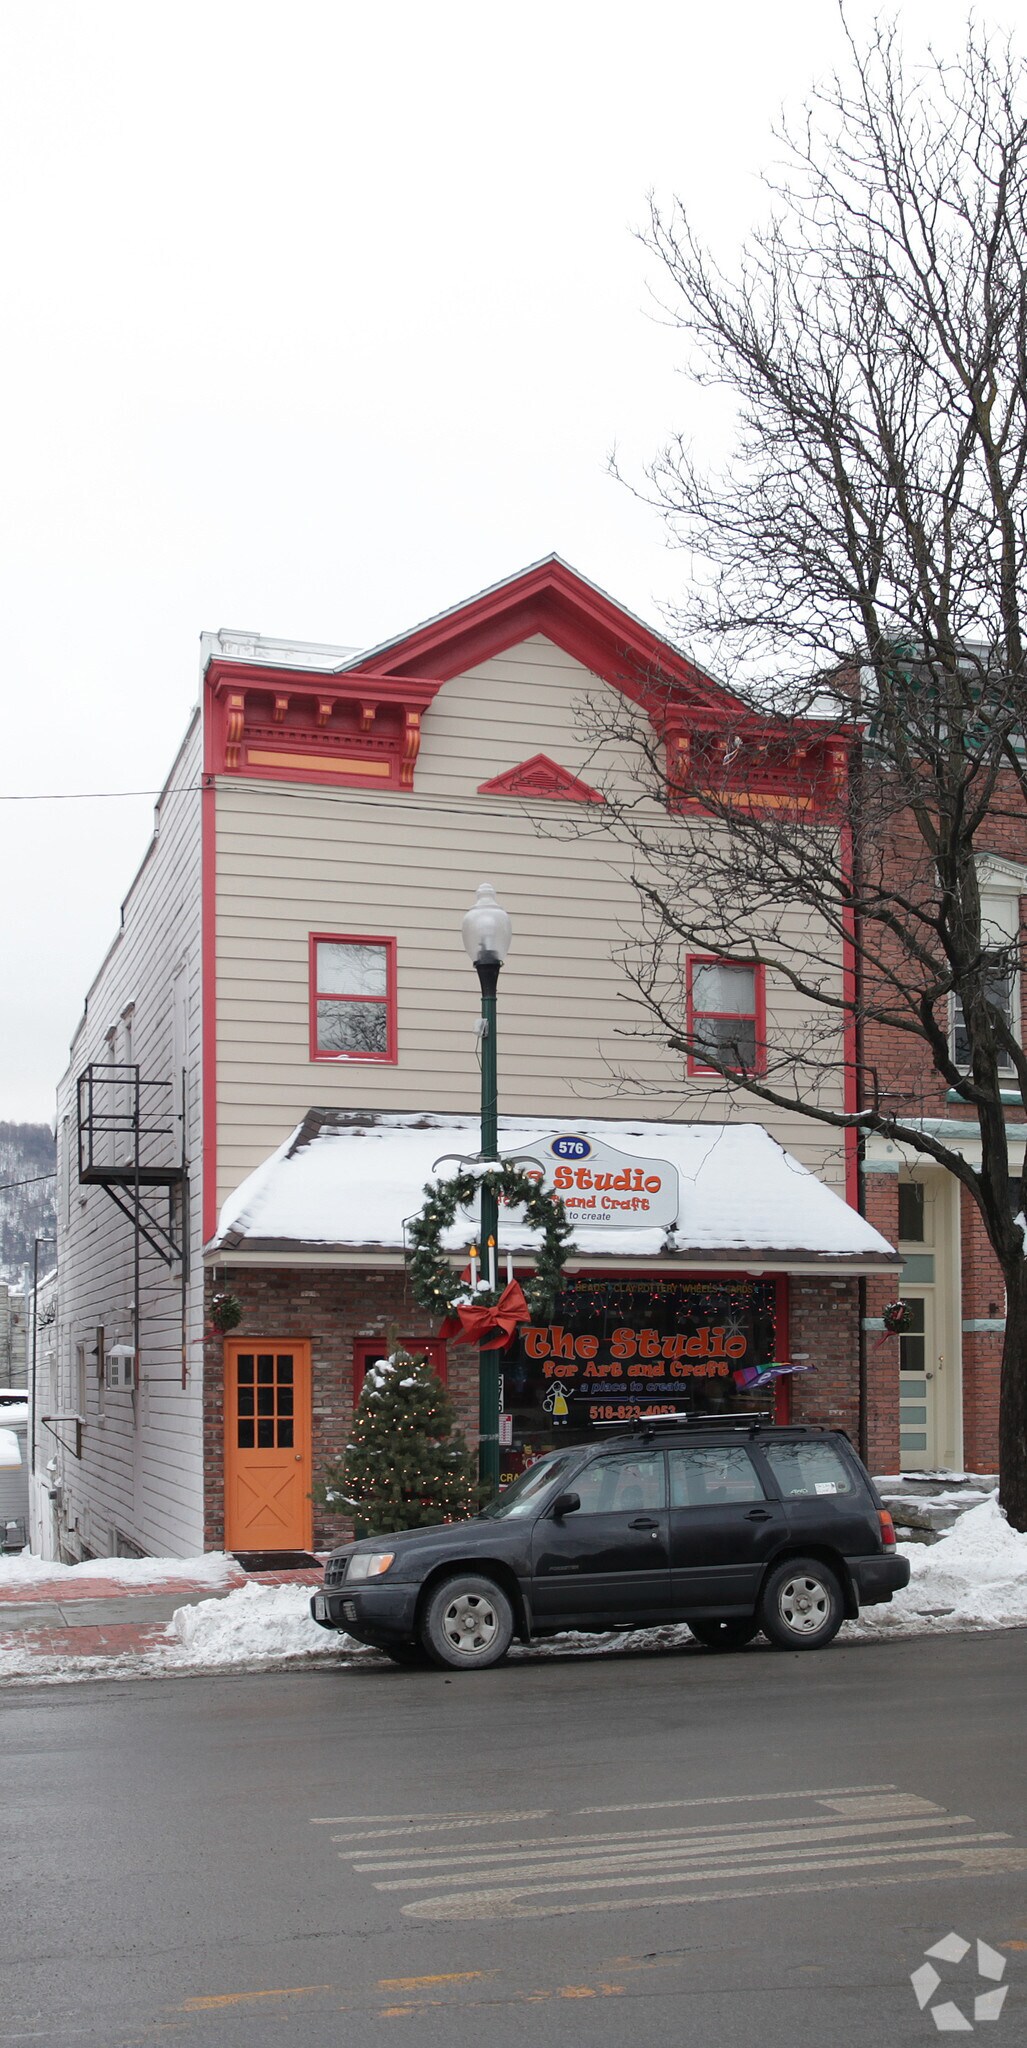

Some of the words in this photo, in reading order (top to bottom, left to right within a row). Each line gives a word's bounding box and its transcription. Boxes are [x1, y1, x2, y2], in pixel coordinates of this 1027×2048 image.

[558, 1141, 584, 1154] 576
[553, 1166, 662, 1193] Studio
[565, 1195, 596, 1208] and
[601, 1195, 650, 1211] Craft
[569, 1211, 579, 1220] to
[582, 1212, 611, 1221] create
[575, 1283, 606, 1292] BEADS
[520, 1326, 599, 1360] The
[610, 1327, 747, 1360] Studio
[542, 1361, 578, 1378] for
[583, 1361, 623, 1378] Art
[627, 1361, 665, 1378] and
[670, 1360, 730, 1378] Craft
[580, 1383, 589, 1392] a
[591, 1381, 627, 1394] place
[630, 1381, 643, 1392] to
[646, 1381, 686, 1392] create
